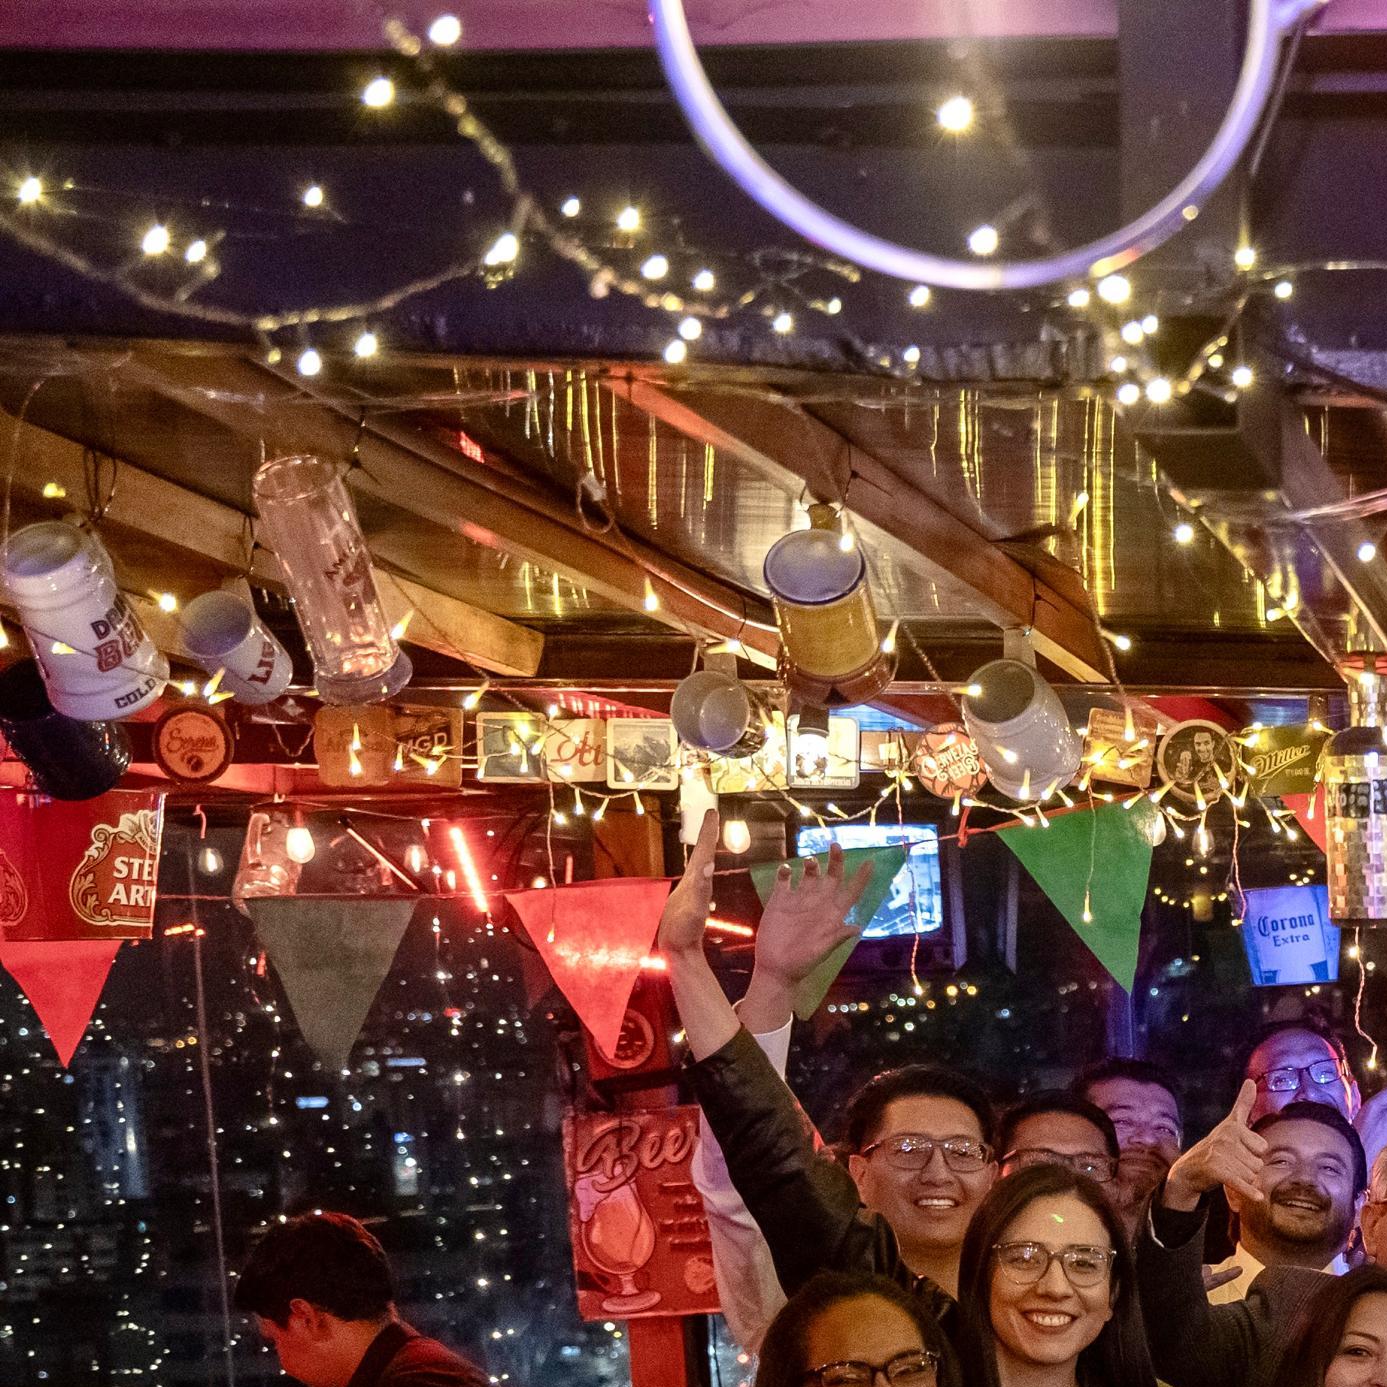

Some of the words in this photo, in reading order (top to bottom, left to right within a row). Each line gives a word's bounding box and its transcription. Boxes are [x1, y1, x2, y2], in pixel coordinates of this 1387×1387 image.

[1251, 745, 1311, 780] Miller
[1257, 912, 1315, 937] Corona
[1273, 932, 1311, 948] Extra
